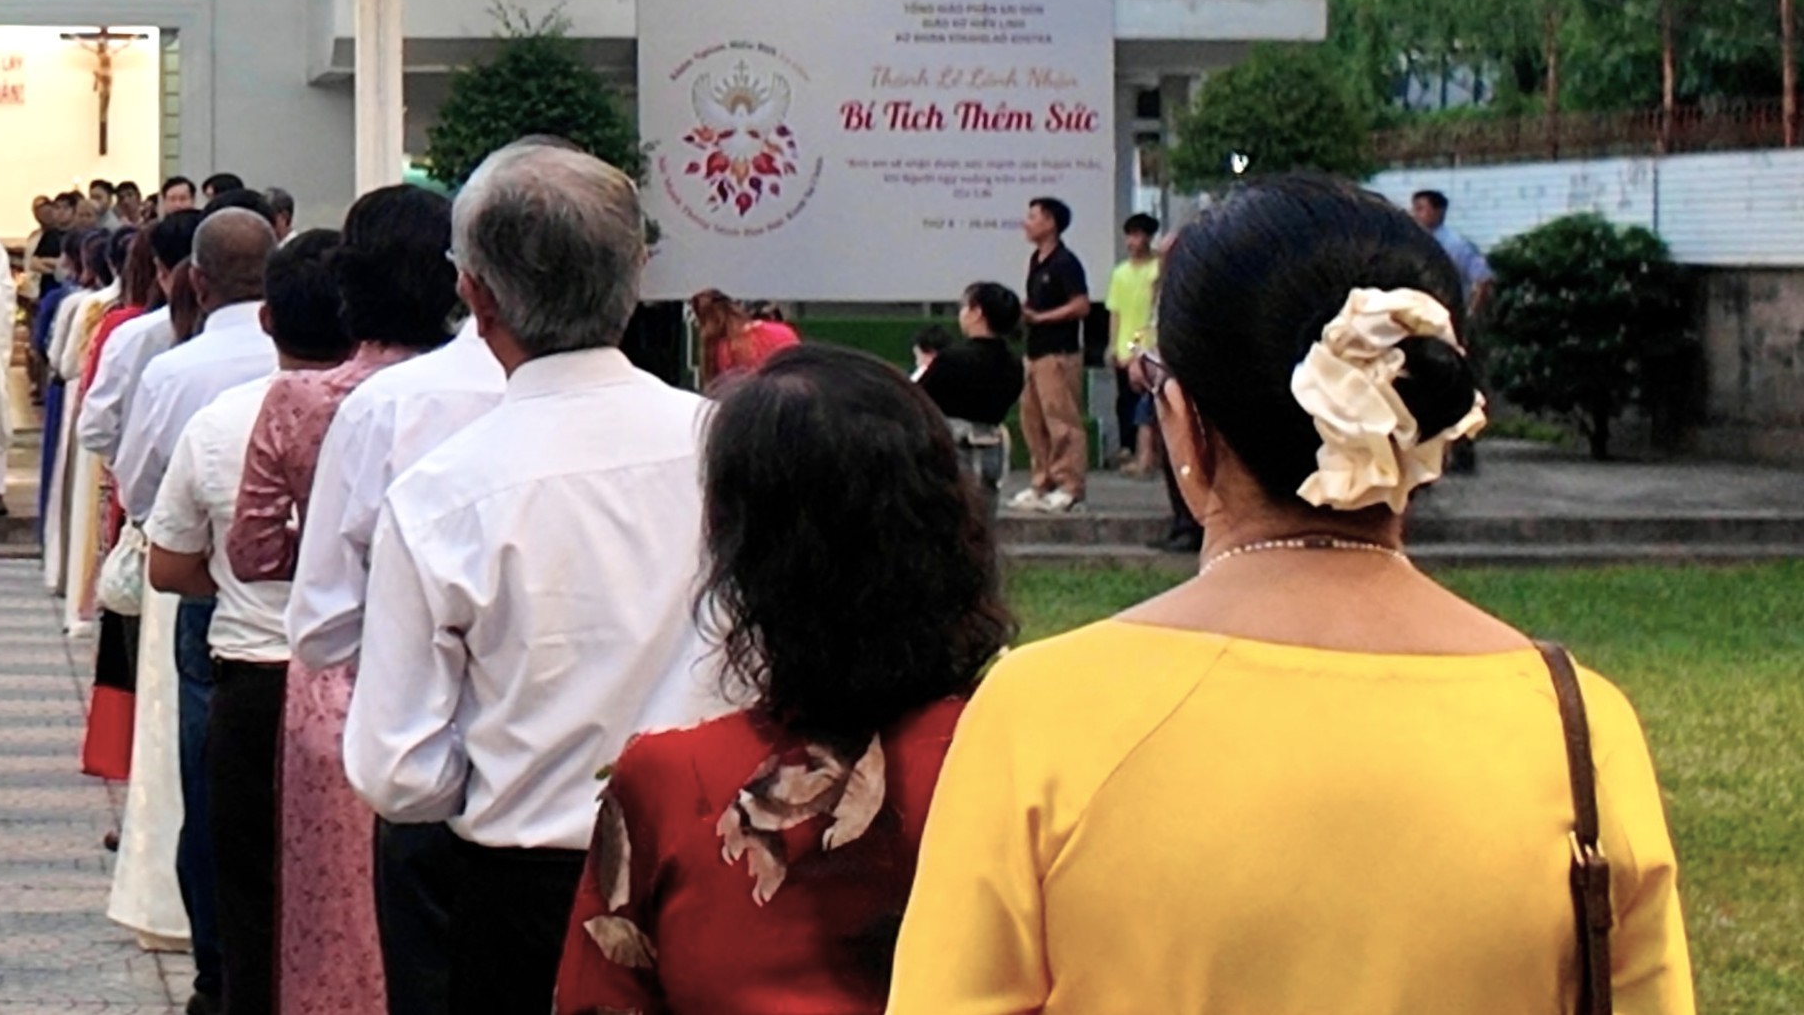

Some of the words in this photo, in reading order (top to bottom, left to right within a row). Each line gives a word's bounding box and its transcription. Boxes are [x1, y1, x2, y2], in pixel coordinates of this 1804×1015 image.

[839, 99, 876, 132] Bí
[882, 99, 947, 132] Tích
[952, 99, 1035, 132] Thêm
[1043, 99, 1101, 132] Sức
